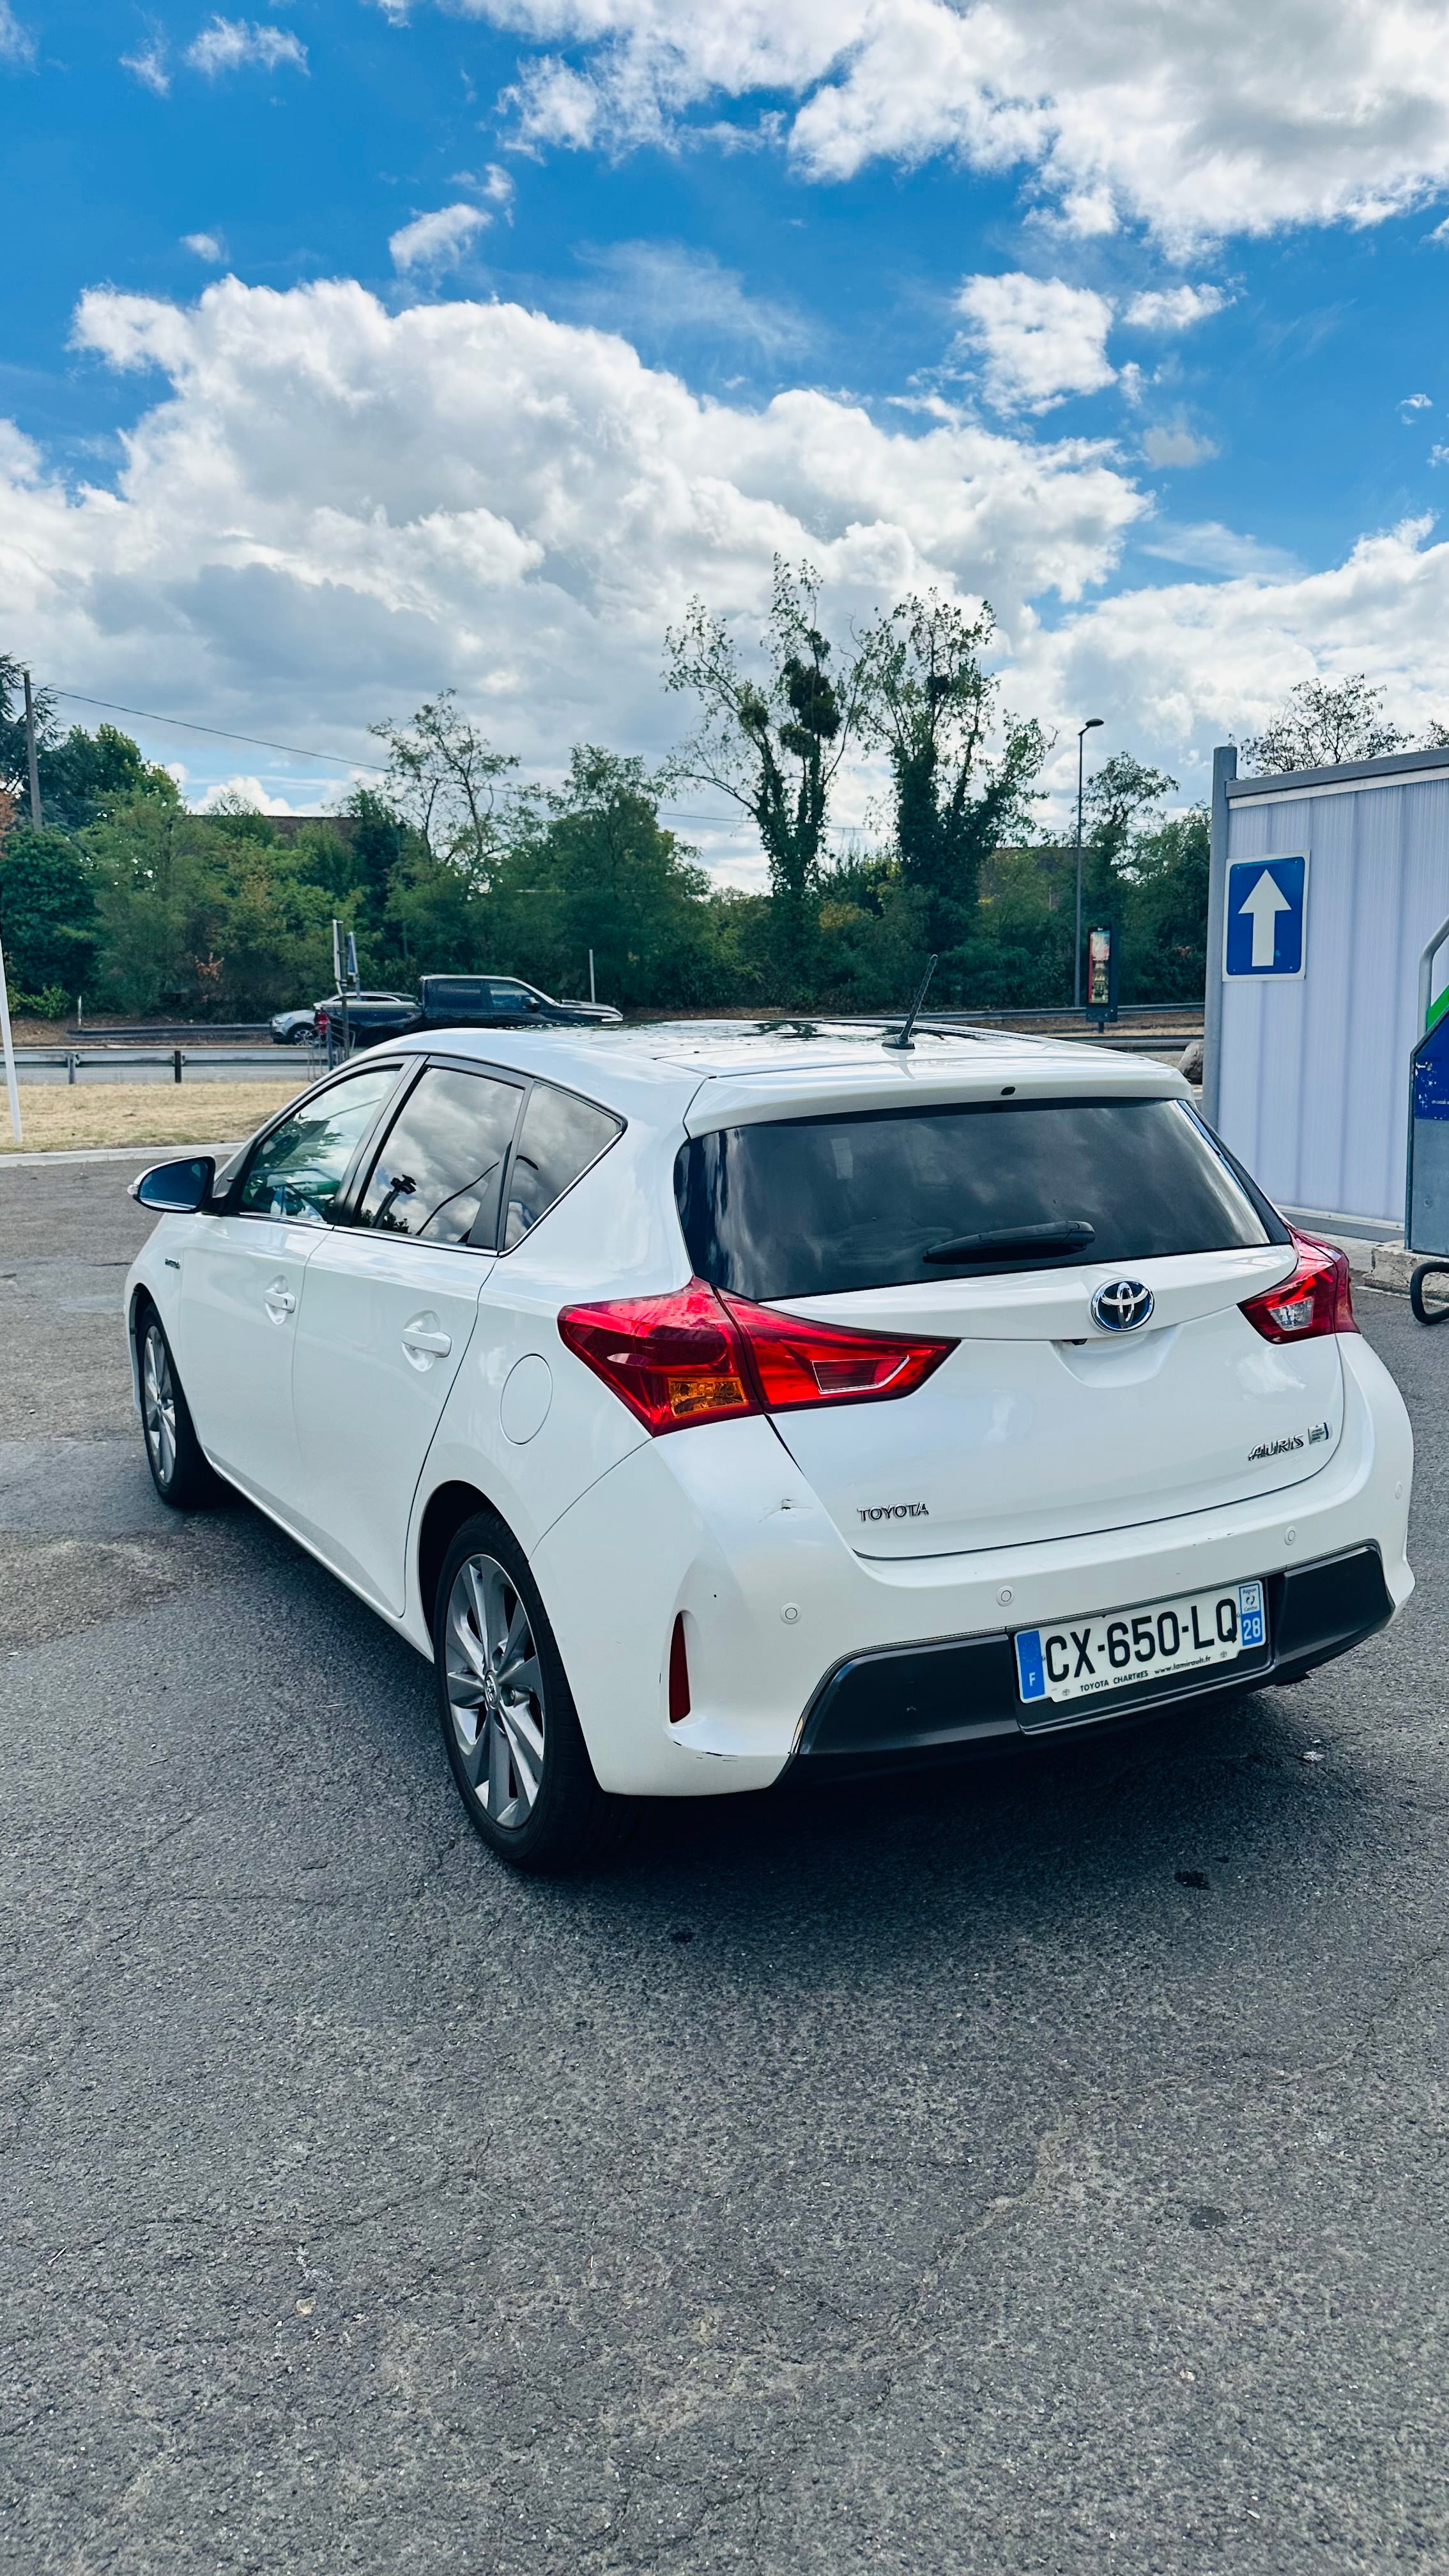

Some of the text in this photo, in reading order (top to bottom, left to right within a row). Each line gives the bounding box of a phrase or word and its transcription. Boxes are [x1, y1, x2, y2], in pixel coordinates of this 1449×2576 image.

[1248, 1434, 1304, 1461] AURIS
[857, 1501, 929, 1522] TOYOTA
[1045, 1598, 1238, 1682] CX-650-LQ
[1243, 1617, 1261, 1641] 28
[1029, 1672, 1036, 1687] F
[1080, 1655, 1211, 1692] TOYOTA CHARTRES www.lamirault.fr
